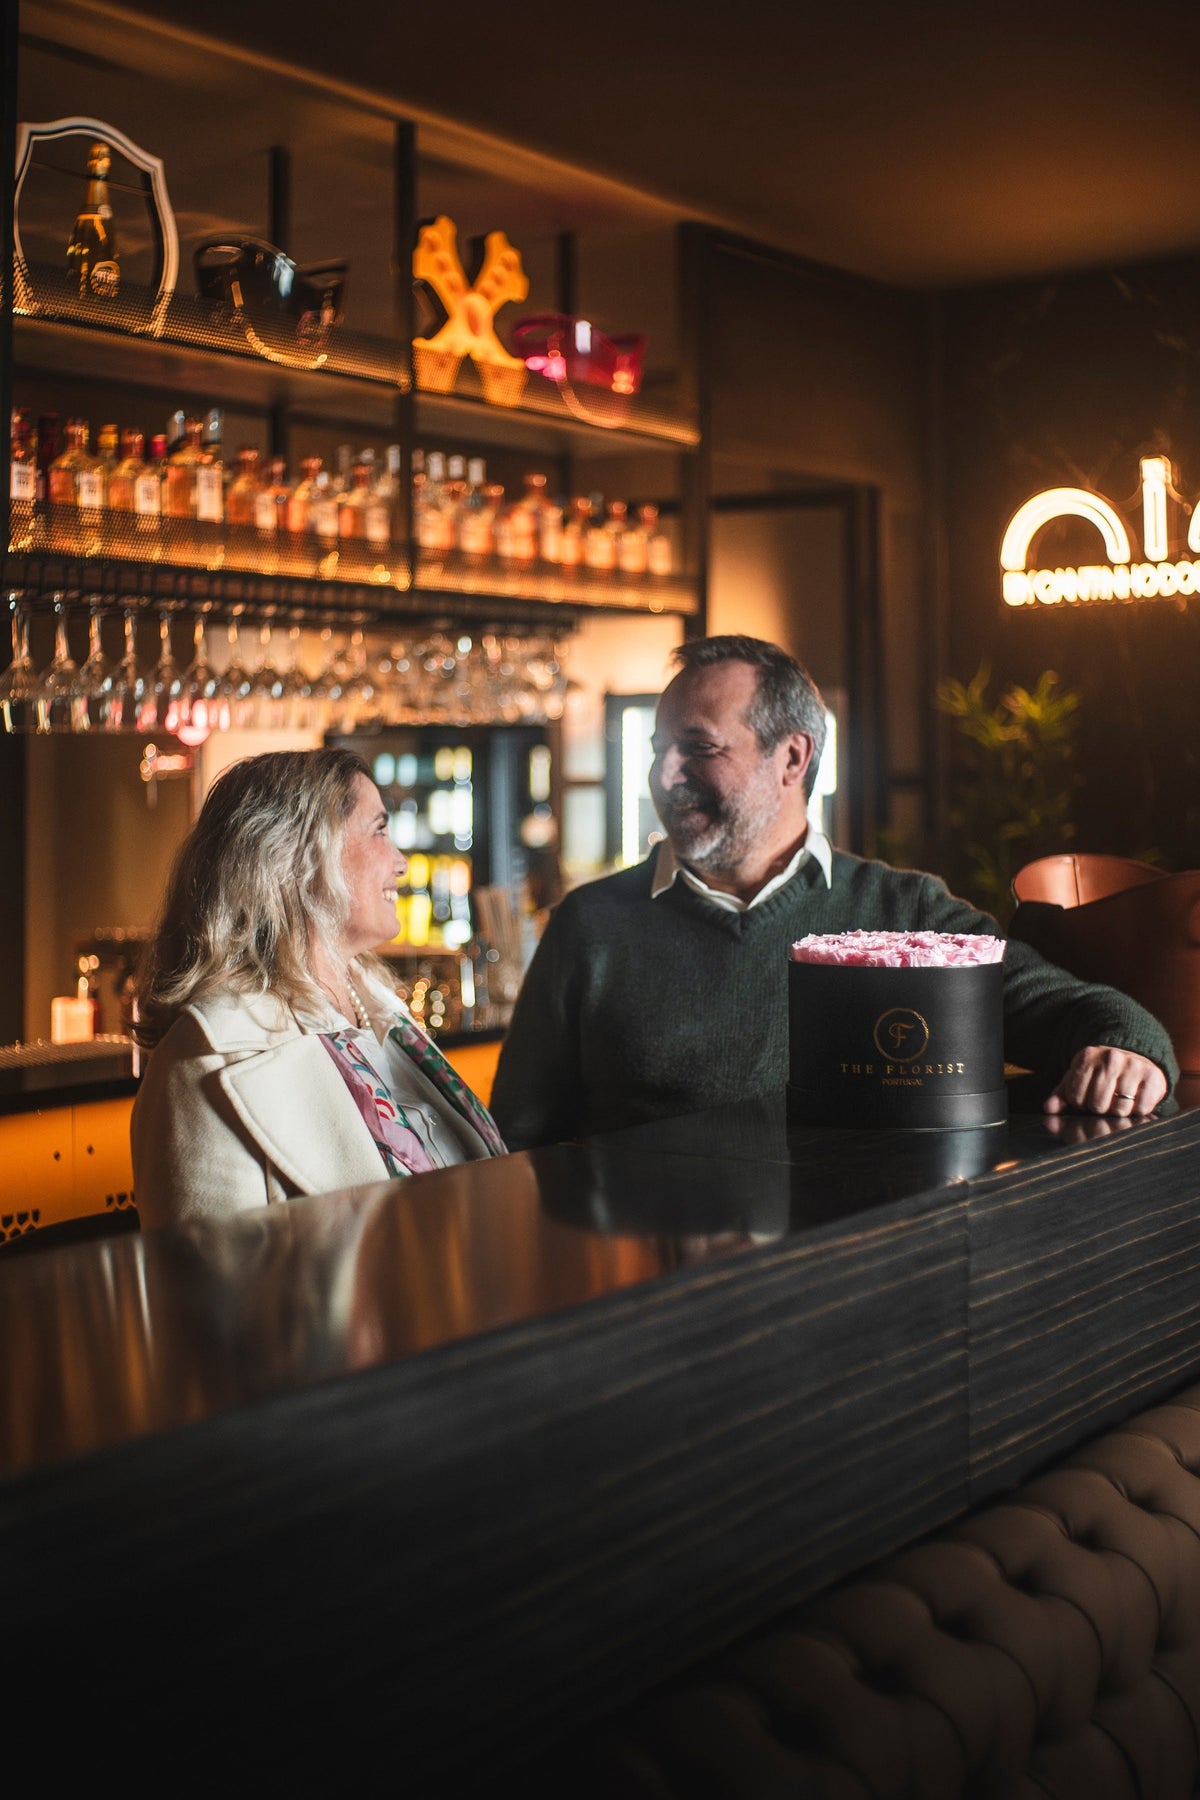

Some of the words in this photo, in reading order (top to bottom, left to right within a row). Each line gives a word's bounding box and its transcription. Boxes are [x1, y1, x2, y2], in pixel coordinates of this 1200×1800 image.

[840, 1063, 874, 1075] THE
[886, 1062, 965, 1075] FLORIST
[882, 1078, 923, 1086] PORTUGAL
